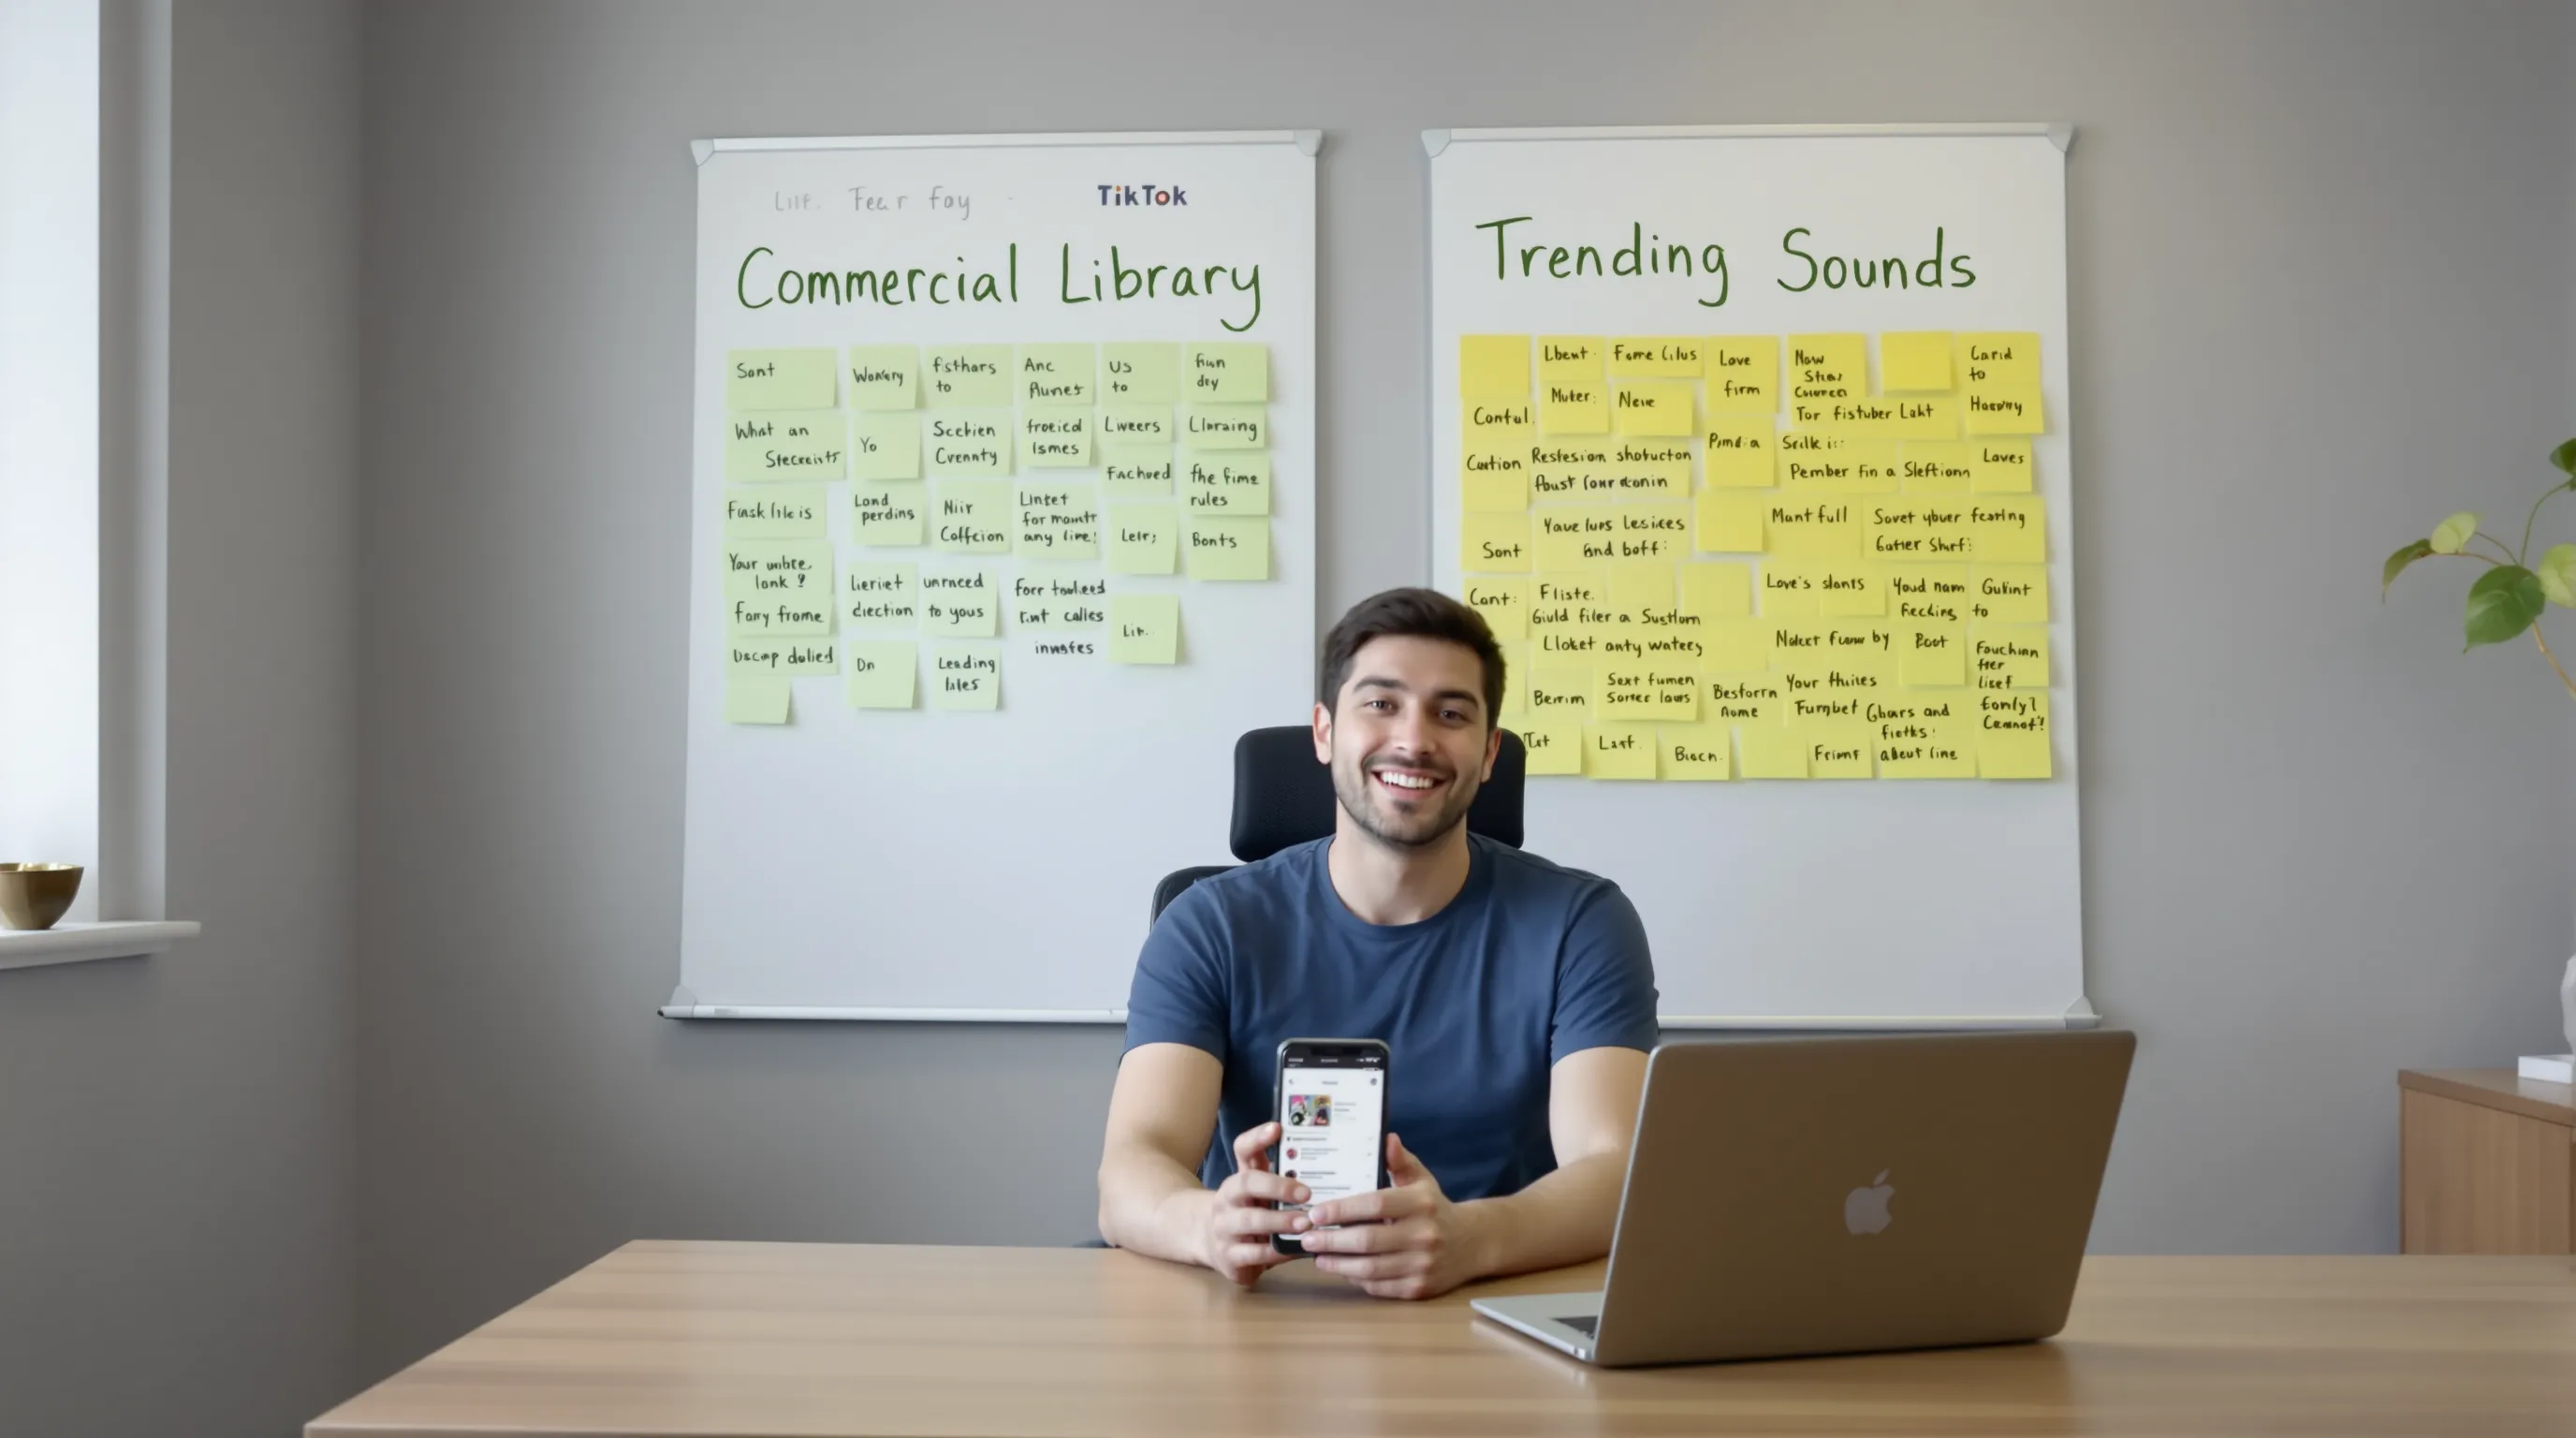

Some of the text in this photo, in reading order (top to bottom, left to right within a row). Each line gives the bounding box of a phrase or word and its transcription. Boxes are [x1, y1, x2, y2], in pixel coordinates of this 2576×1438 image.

[1097, 184, 1188, 207] TikTok
[1474, 215, 1977, 308] Trending Sounds
[737, 242, 1261, 333] Commercial Library
[1968, 366, 1986, 382] to
[935, 379, 952, 393] to
[1111, 380, 1129, 393] to
[860, 436, 878, 454] Yo
[1885, 467, 1896, 477] a
[1817, 504, 1848, 524] full
[928, 604, 943, 618] to
[1618, 613, 1632, 624] a
[1871, 628, 1890, 652] by
[1923, 702, 1951, 718] and
